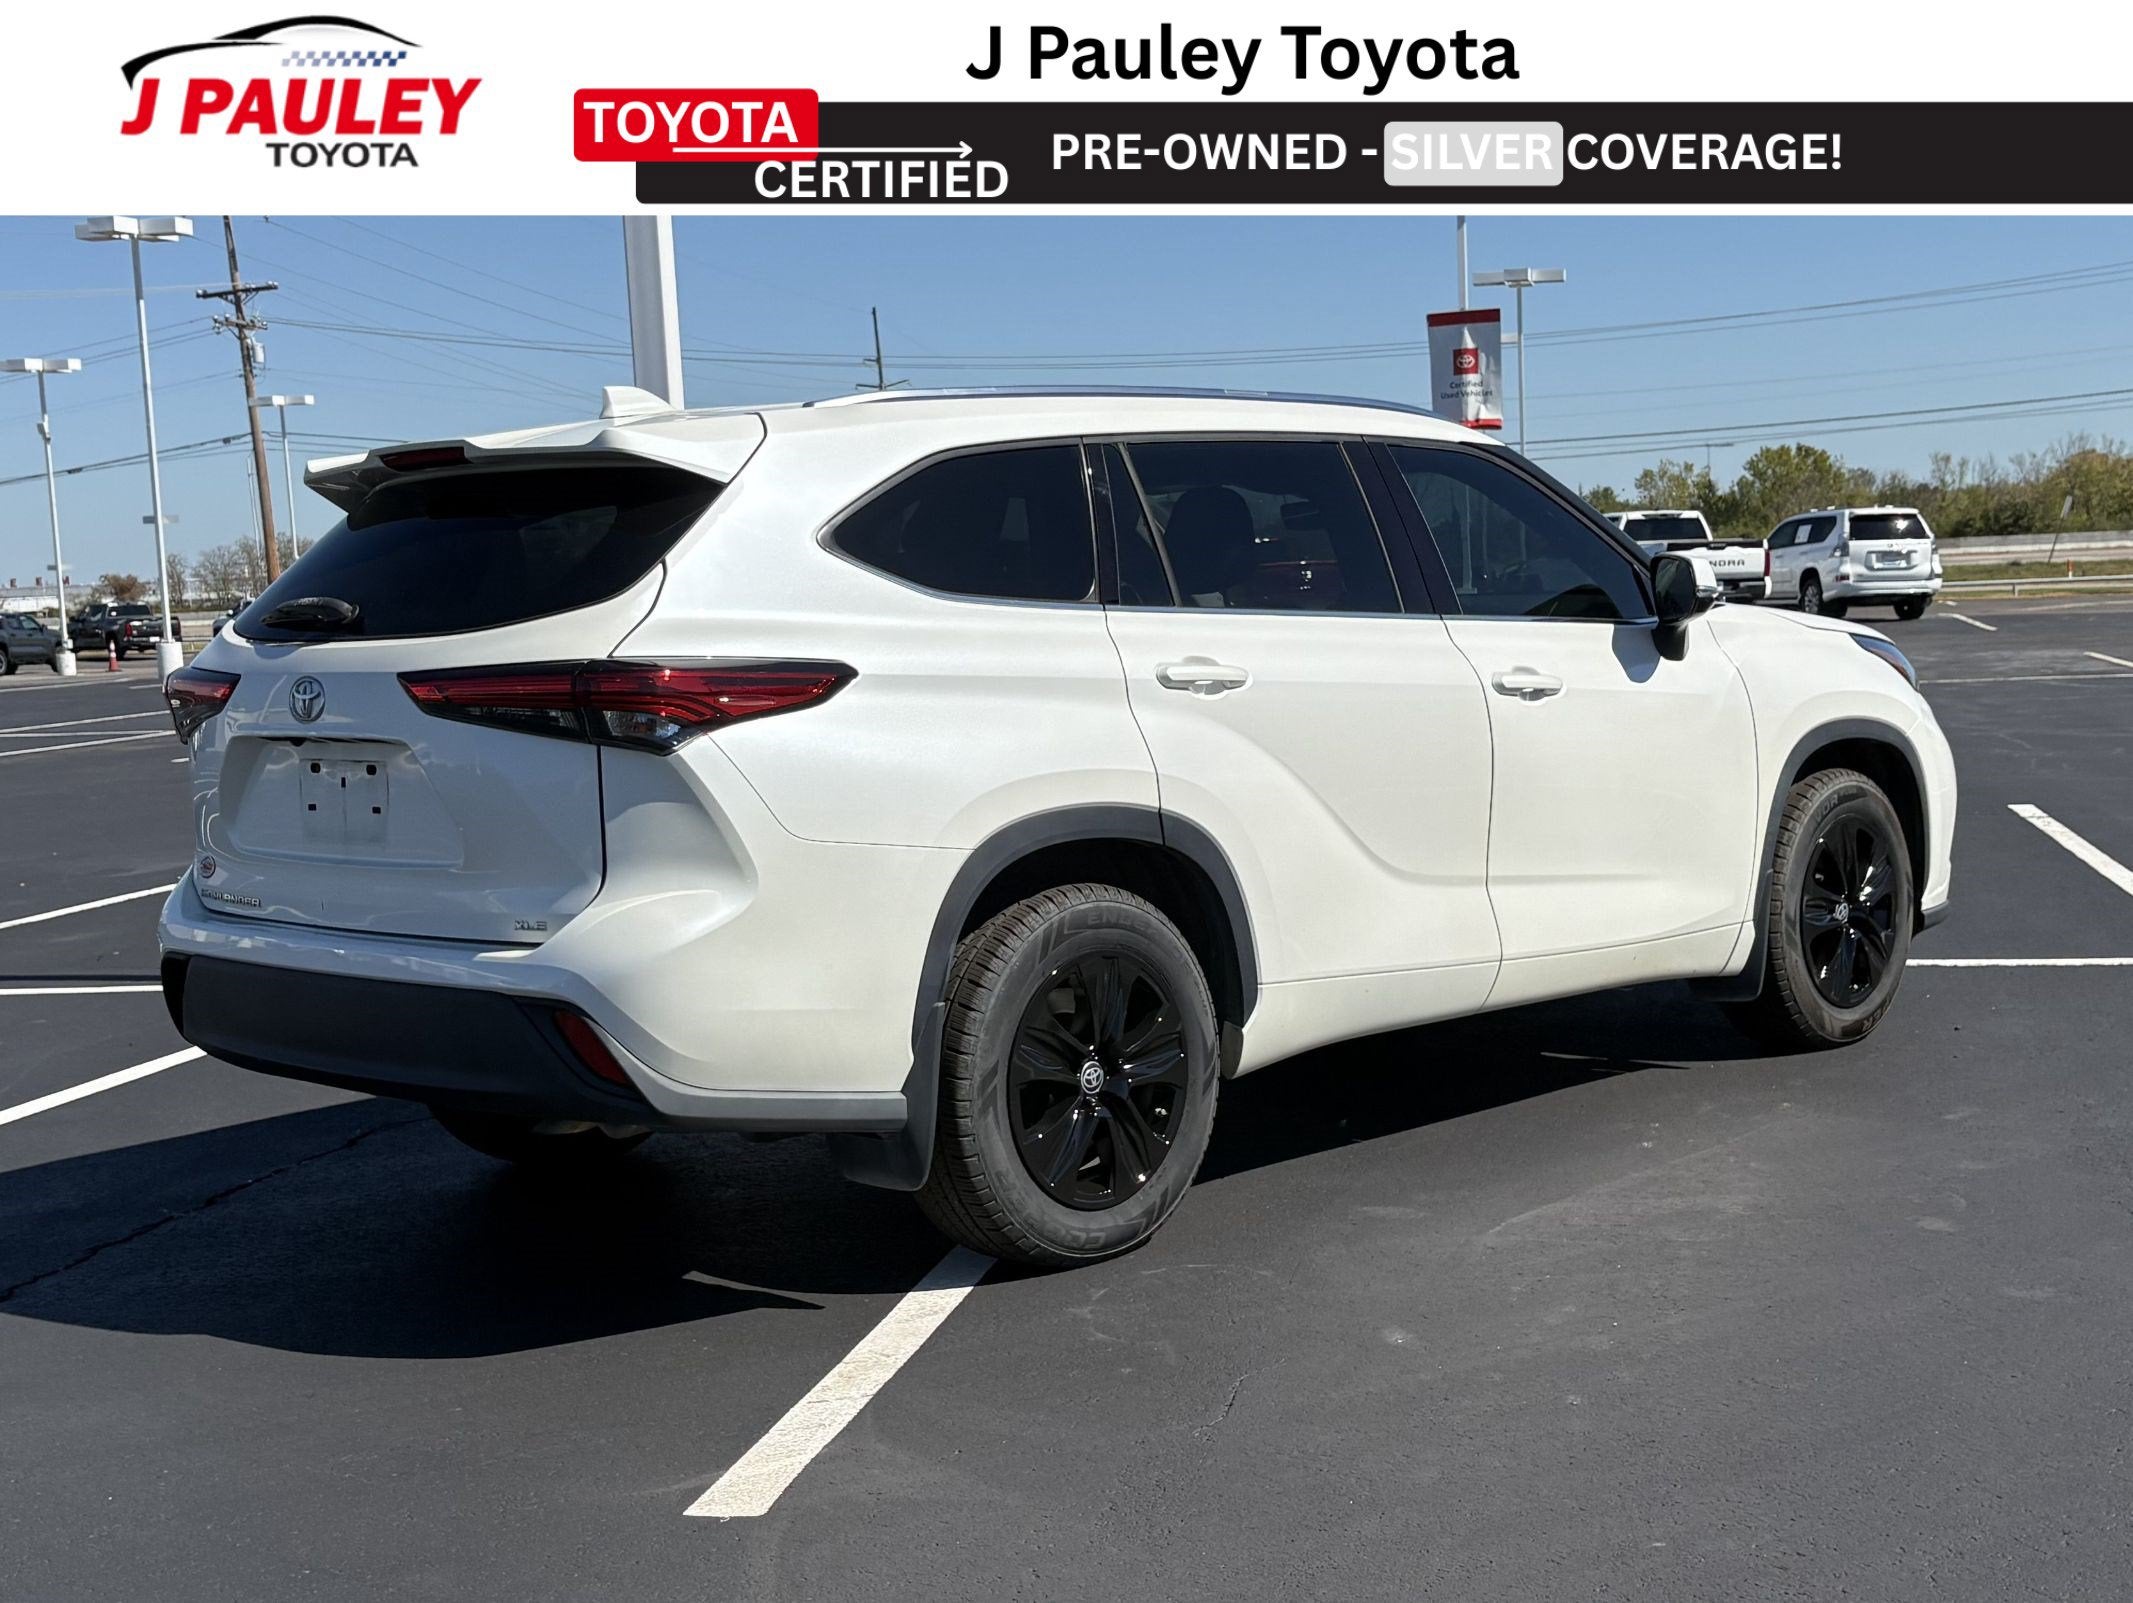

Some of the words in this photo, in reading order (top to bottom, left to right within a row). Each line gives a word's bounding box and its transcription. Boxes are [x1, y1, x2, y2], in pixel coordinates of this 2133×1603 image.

[1450, 380, 1483, 388] Certified
[1440, 390, 1459, 399] Used
[1459, 389, 1493, 398] Vehicles
[1709, 559, 1745, 567] NDRA
[514, 919, 548, 931] XLE
